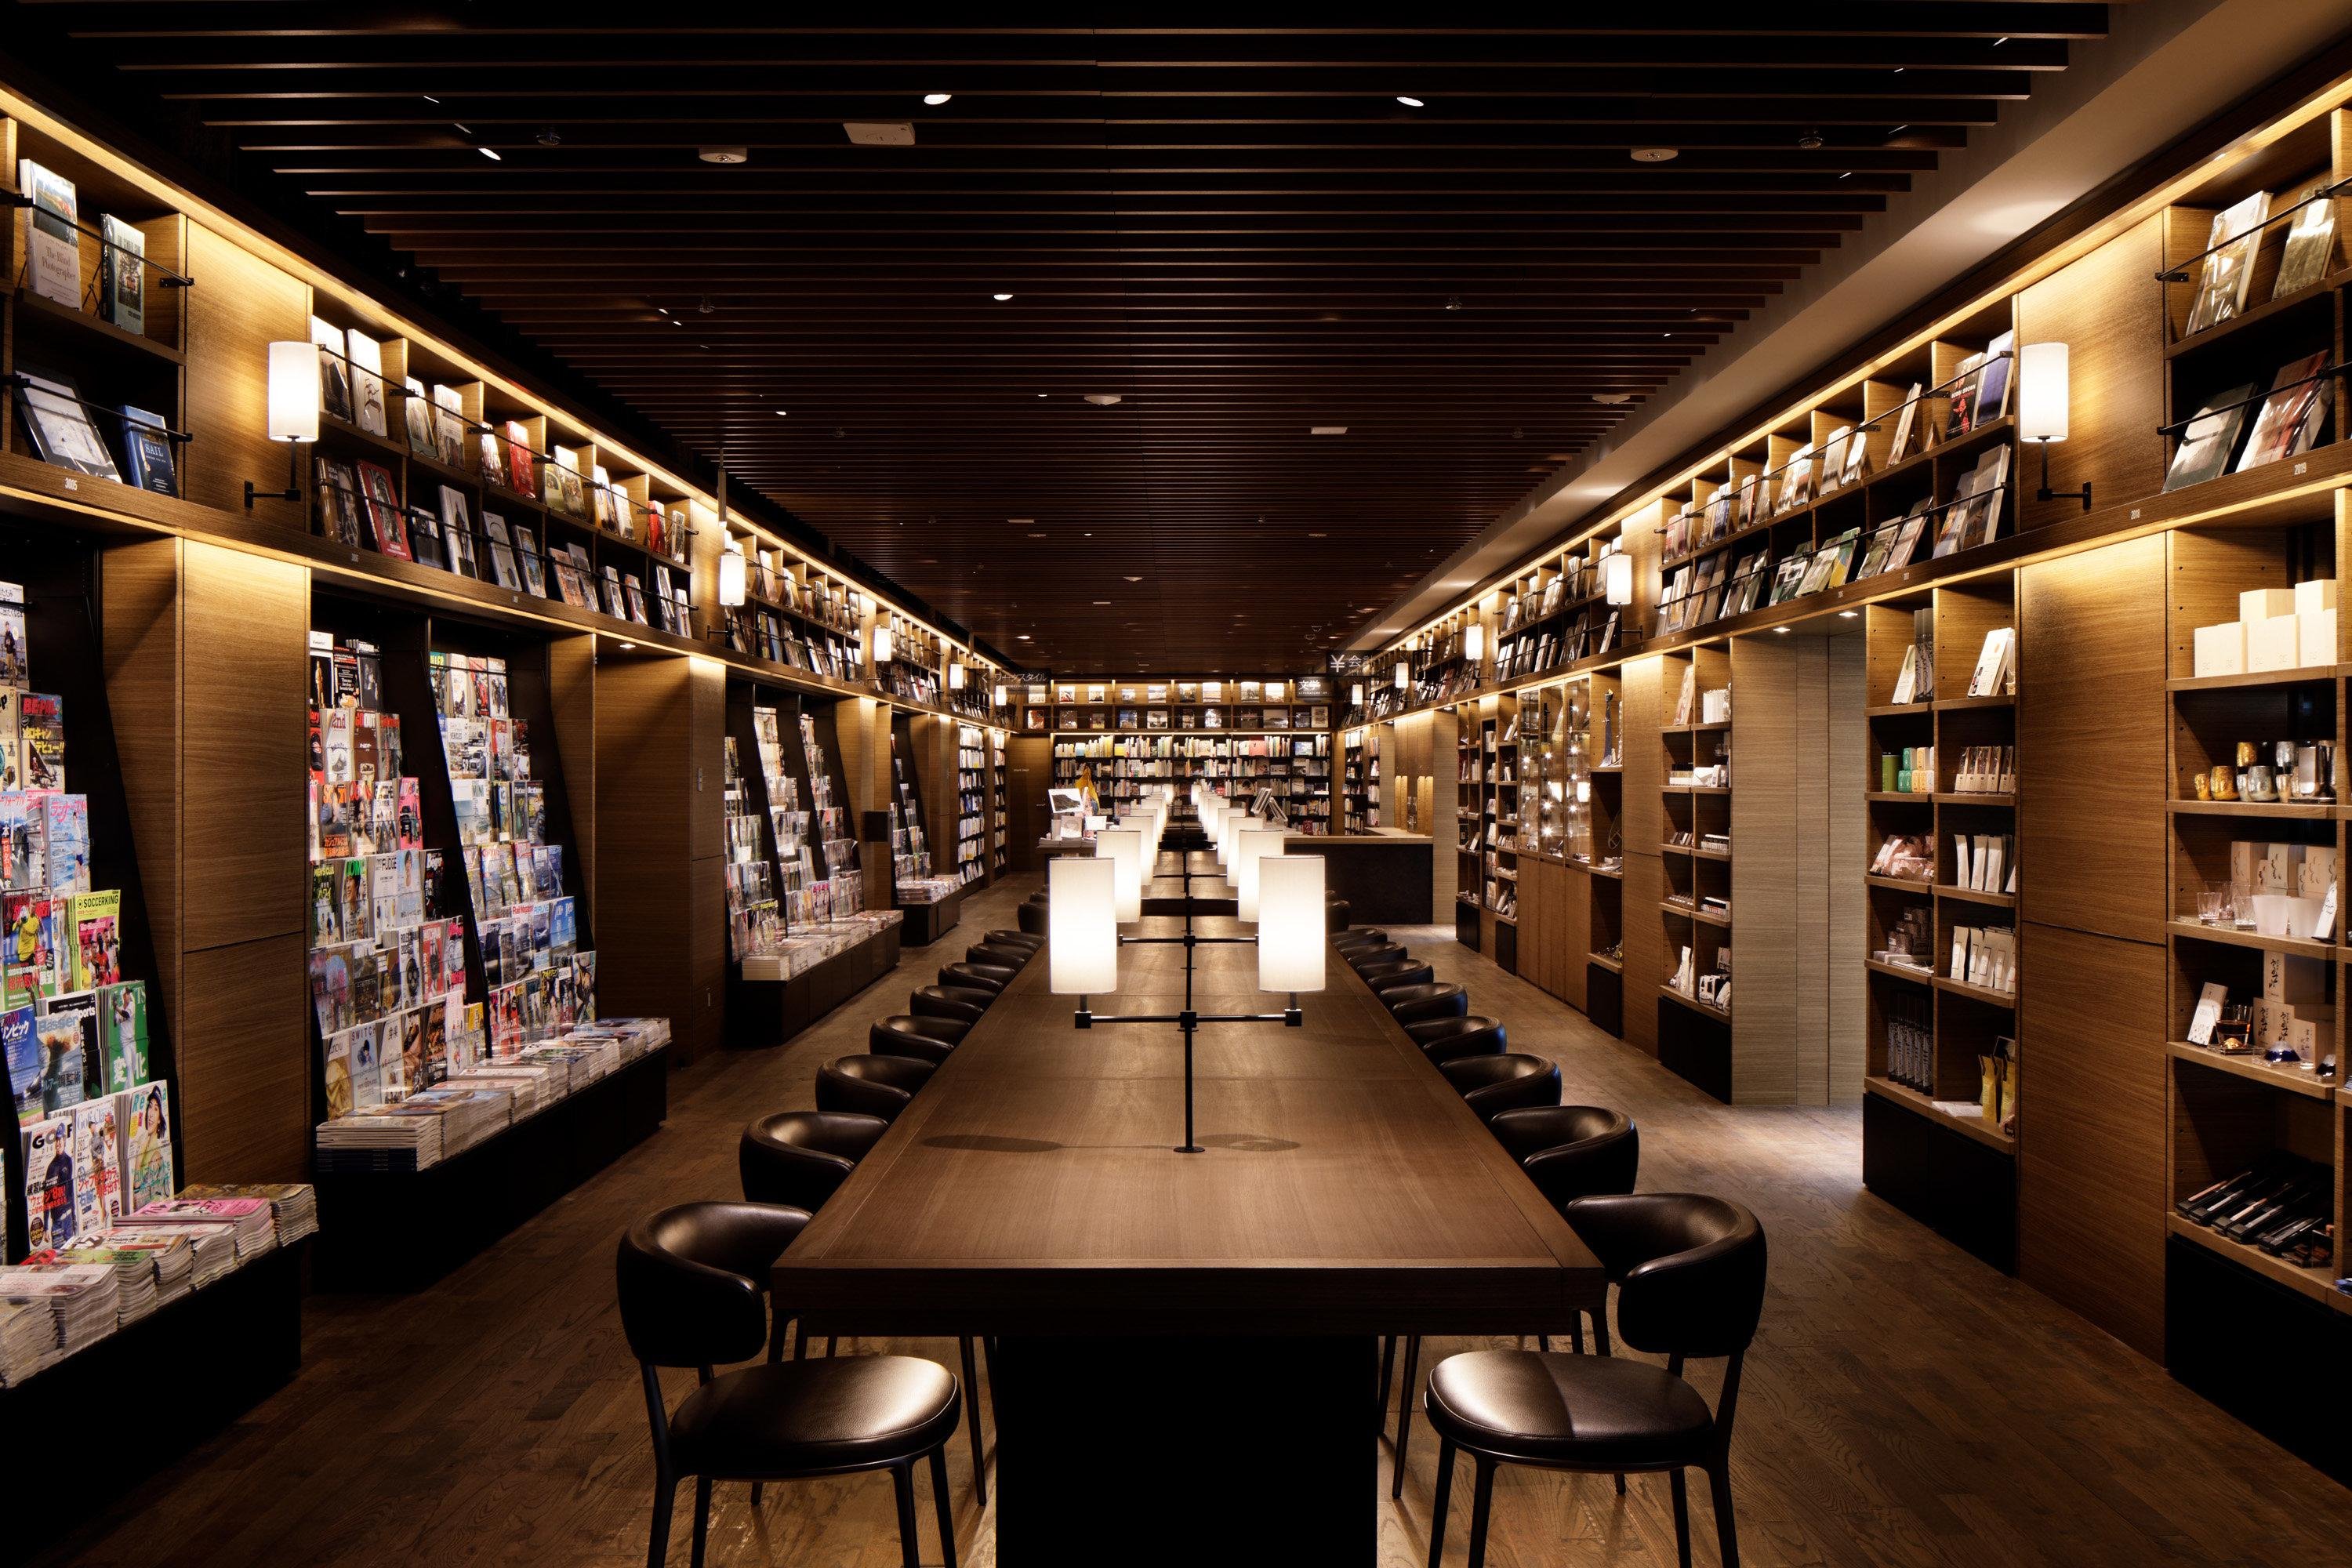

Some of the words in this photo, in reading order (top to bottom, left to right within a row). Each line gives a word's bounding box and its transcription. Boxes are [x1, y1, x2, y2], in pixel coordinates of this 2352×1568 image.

[42, 256, 76, 282] Photographer
[144, 443, 163, 457] SAIL
[2294, 462, 2307, 475] 2019
[83, 895, 118, 909] SOCCERKING
[39, 1016, 78, 1033] Basser
[32, 1123, 72, 1149] GOF
